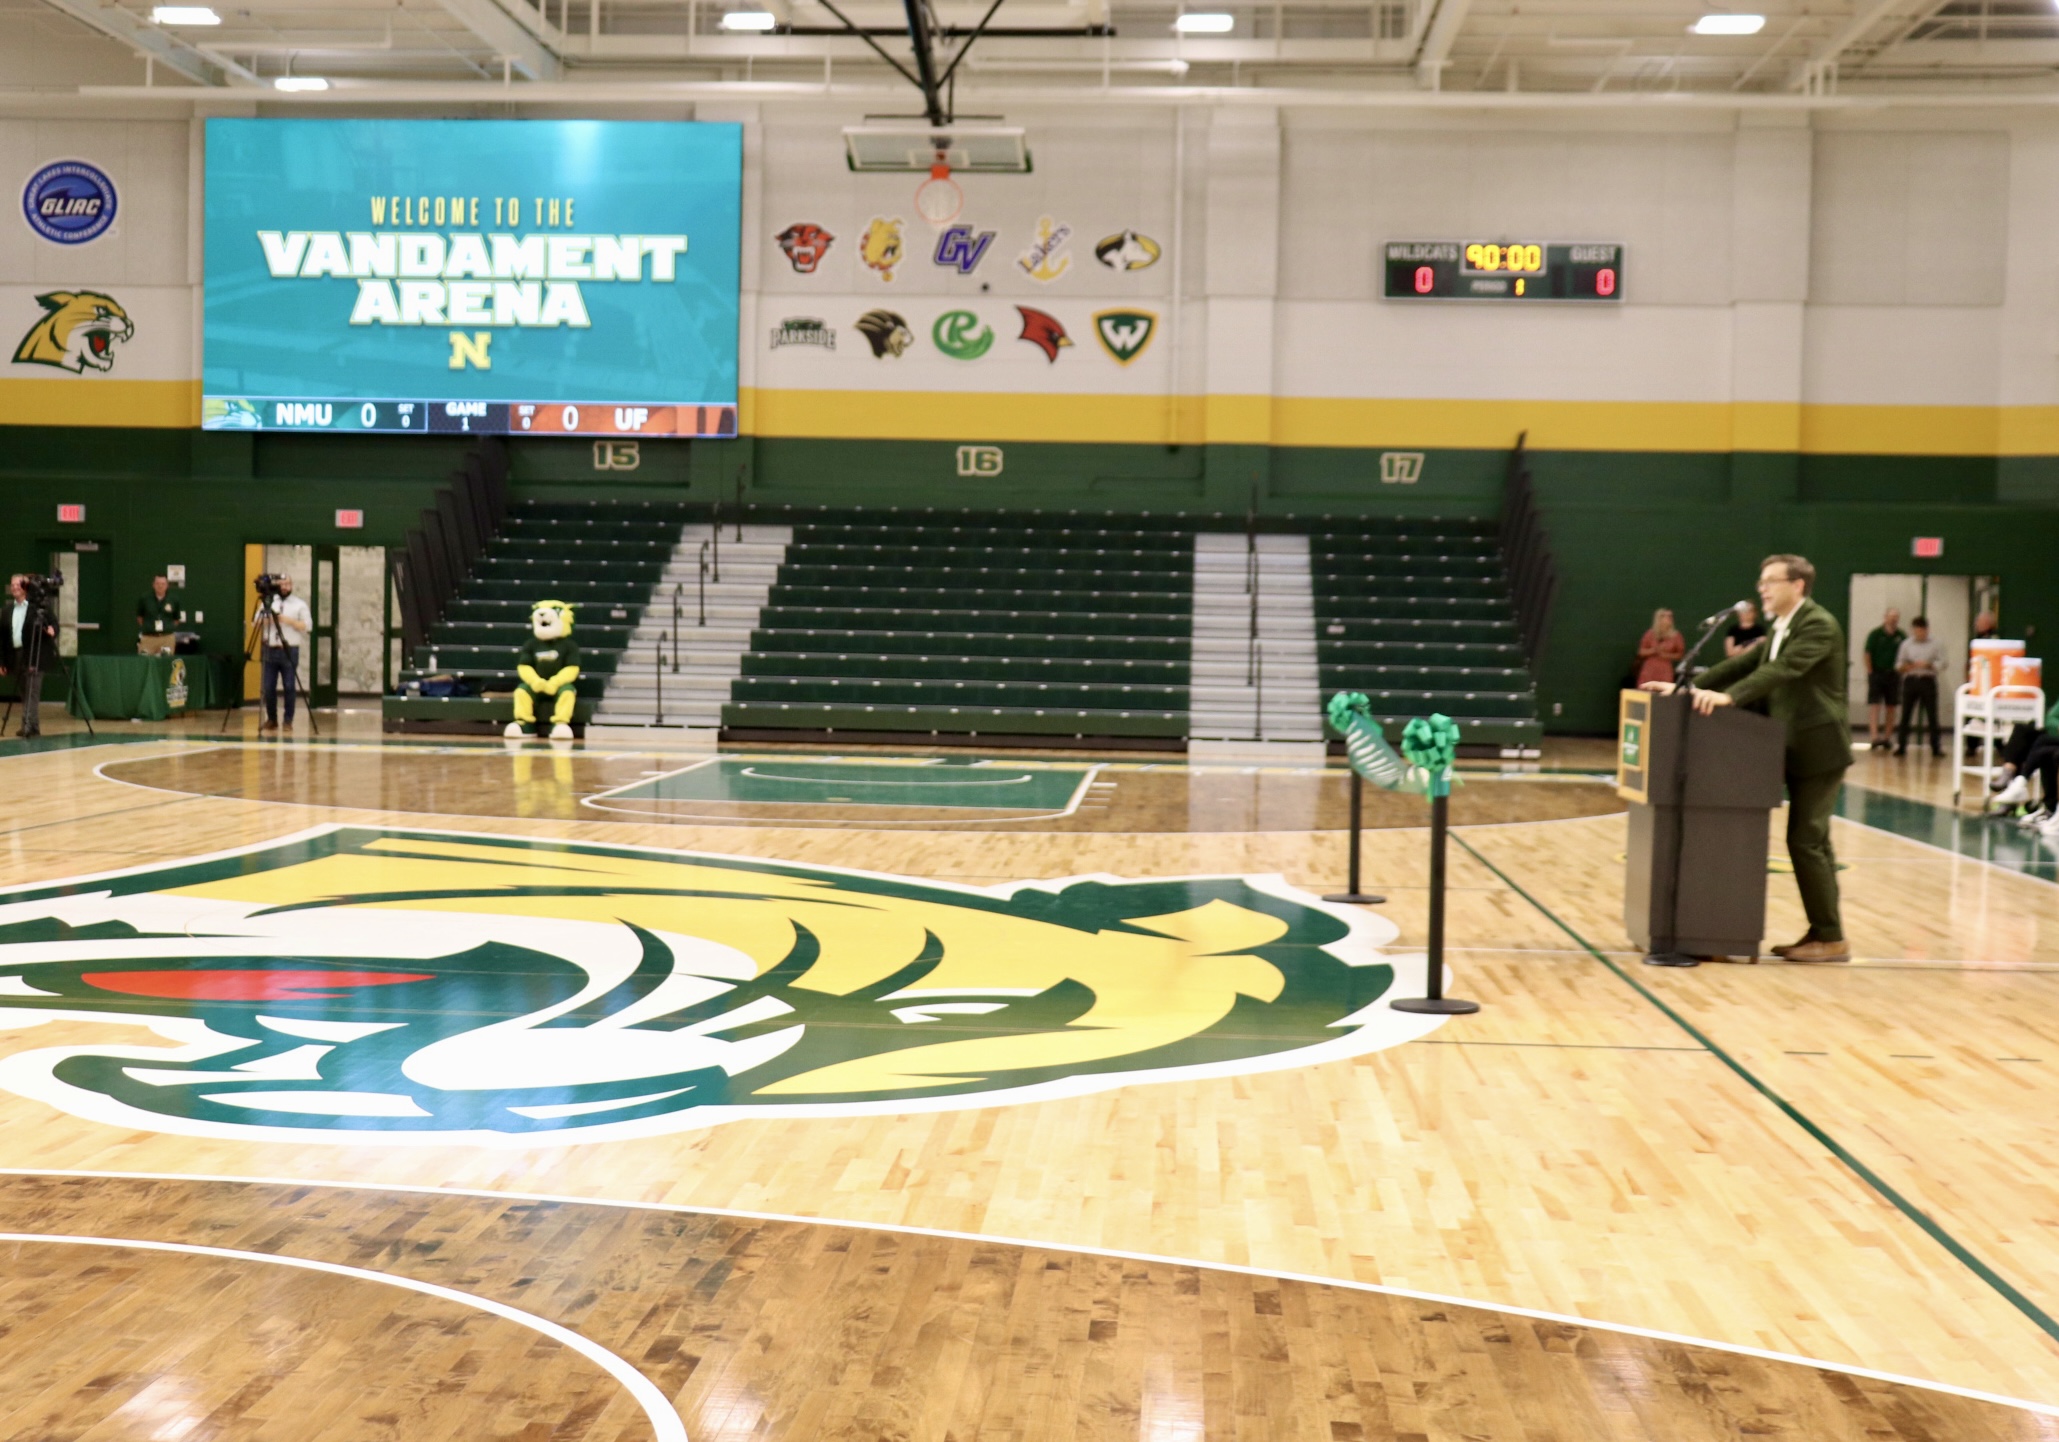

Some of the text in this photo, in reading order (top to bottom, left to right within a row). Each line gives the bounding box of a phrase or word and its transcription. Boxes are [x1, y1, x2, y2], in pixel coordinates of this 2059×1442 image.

[40, 197, 102, 216] GLIAC
[371, 196, 574, 227] WELCOME TO THE
[257, 230, 688, 281] VANDAMENT
[933, 224, 996, 274] GV
[1016, 222, 1071, 274] Lakers
[1388, 246, 1458, 261] WILDCATS
[1466, 244, 1541, 272] 90:00
[1570, 246, 1616, 263] GUEST
[1415, 266, 1434, 293] 0
[1596, 268, 1615, 296] 0
[349, 279, 592, 327] ARENA
[770, 327, 837, 351] PARKSIDE
[1100, 318, 1150, 351] W
[449, 331, 491, 369] N
[275, 402, 377, 428] NMU 0
[397, 403, 415, 415] SET
[401, 414, 411, 428] 0
[445, 402, 488, 416] GAME
[518, 405, 536, 416] SET
[562, 405, 649, 431] 0 UF
[461, 417, 470, 431] 1
[521, 416, 532, 430] 0
[593, 441, 640, 470] 15
[956, 446, 1003, 476] 16
[1380, 452, 1425, 483] 17
